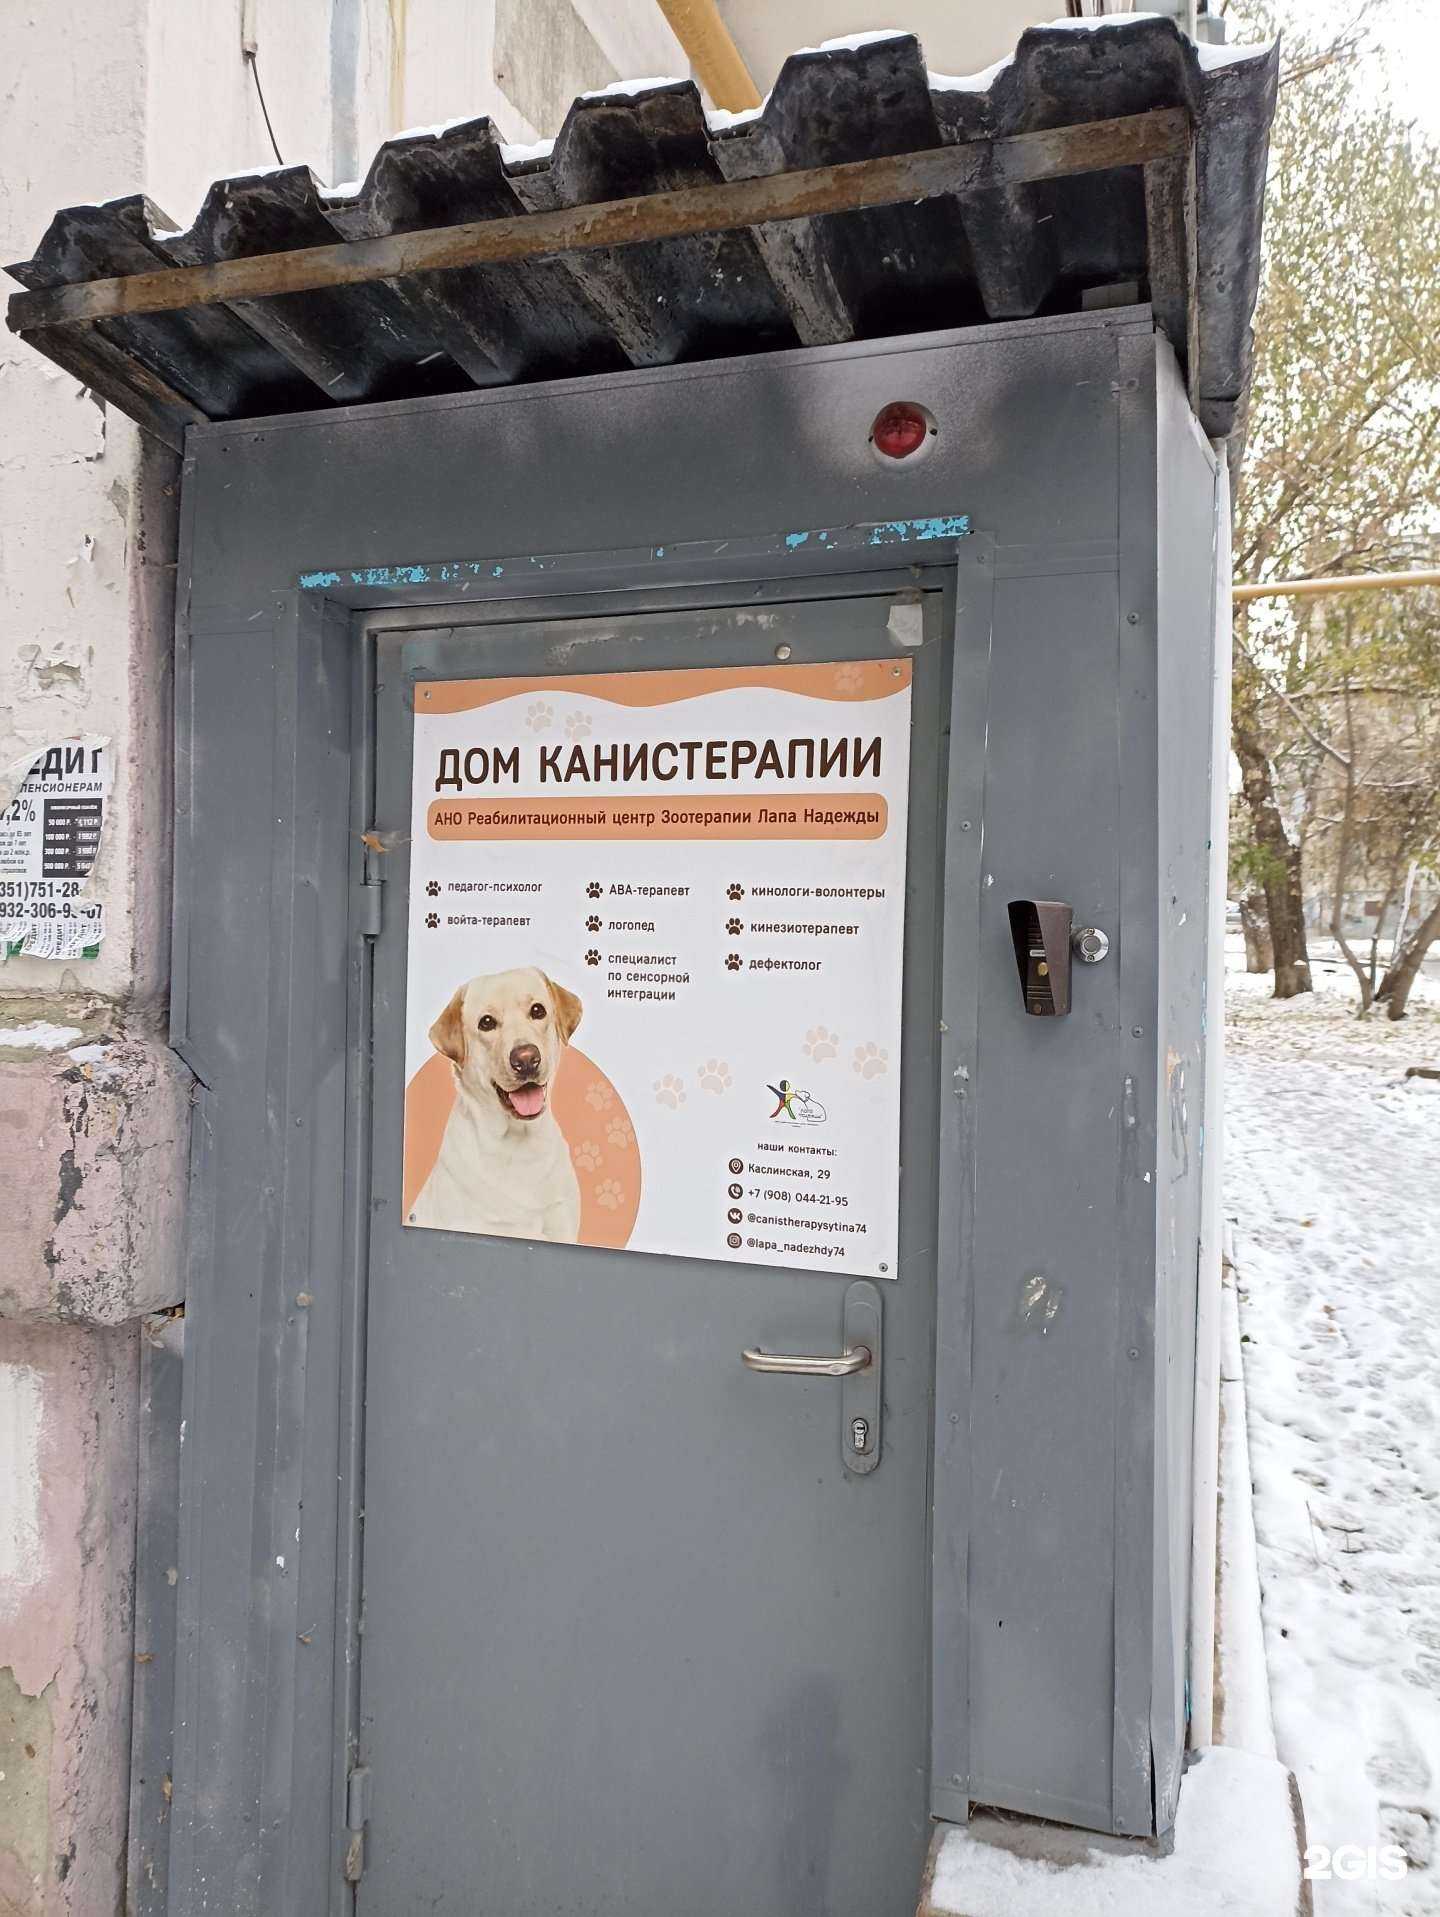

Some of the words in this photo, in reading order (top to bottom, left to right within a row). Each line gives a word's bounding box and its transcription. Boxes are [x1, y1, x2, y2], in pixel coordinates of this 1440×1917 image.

[435, 747, 520, 792] ДОМ
[540, 737, 882, 783] КАНИСТЕРАПИИ
[20, 783, 103, 793] ПЕНСИОНЕРАМ
[435, 812, 462, 826] АНО
[468, 811, 606, 827] Реабилитационный
[613, 811, 655, 827] центр
[661, 809, 751, 826] Зоотерапии
[758, 809, 797, 823] Лапа
[804, 808, 879, 824] Надежды
[448, 882, 542, 893] педагог-психолог
[751, 886, 885, 900] кинологи-волонтеры
[447, 914, 531, 927] войта-терапевт
[608, 920, 655, 932] логопед
[750, 922, 859, 936] кинезиотерапевт
[608, 954, 677, 965] специалист
[749, 958, 822, 971] дефектолог
[608, 972, 622, 981] по
[626, 972, 690, 984] сенсорной
[607, 988, 676, 1001] интеграции
[757, 1142, 784, 1152] наши
[788, 1145, 837, 1156] контакты:
[748, 1163, 813, 1179] Каслинская,
[817, 1169, 831, 1179] 29
[748, 1188, 760, 1198] +7
[763, 1189, 791, 1203] (908)
[795, 1192, 849, 1206] 044-21-95
[747, 1212, 867, 1234] @canistherapysytina74
[746, 1237, 845, 1257] @lapa_nadezhdy74
